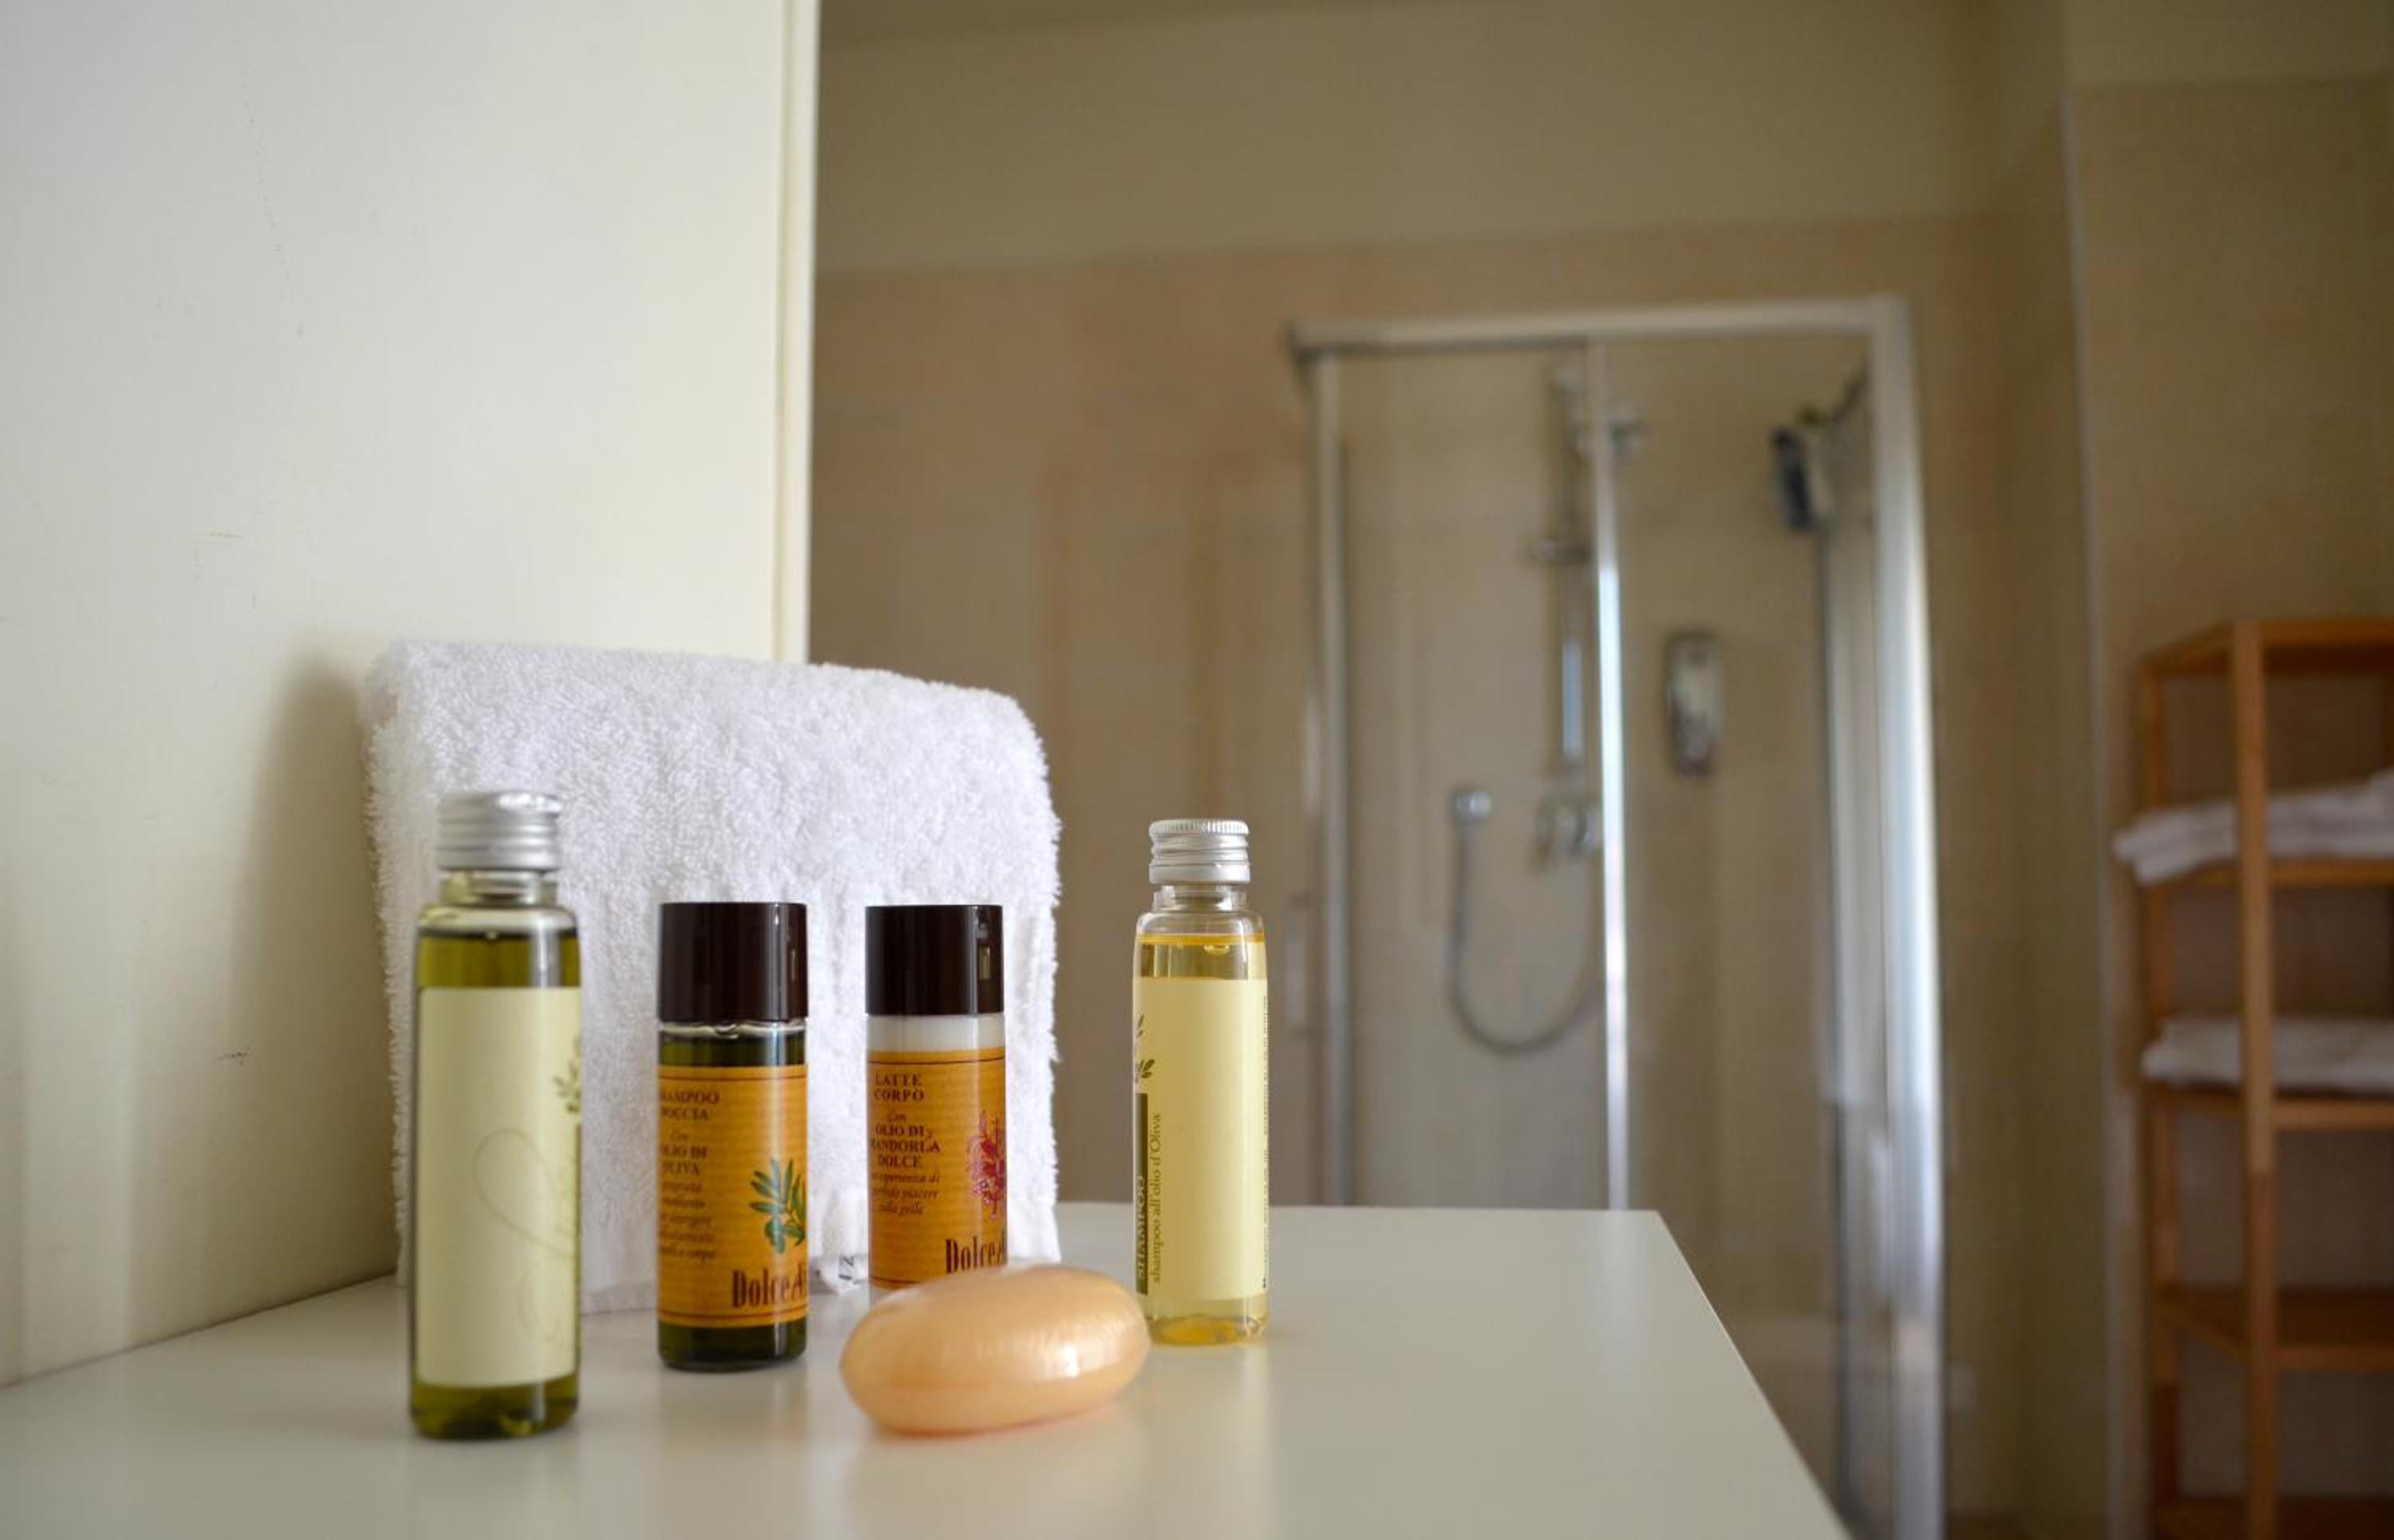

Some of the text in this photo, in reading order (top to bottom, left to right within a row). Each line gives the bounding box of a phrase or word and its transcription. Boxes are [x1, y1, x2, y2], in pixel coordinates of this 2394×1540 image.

[875, 1073, 922, 1087] LATTE
[874, 1088, 925, 1102] CORPO
[875, 1124, 924, 1136] OLIO DI
[690, 1146, 708, 1159] DI
[878, 1154, 922, 1168] DOLCE
[1148, 1220, 1163, 1283] shampoo
